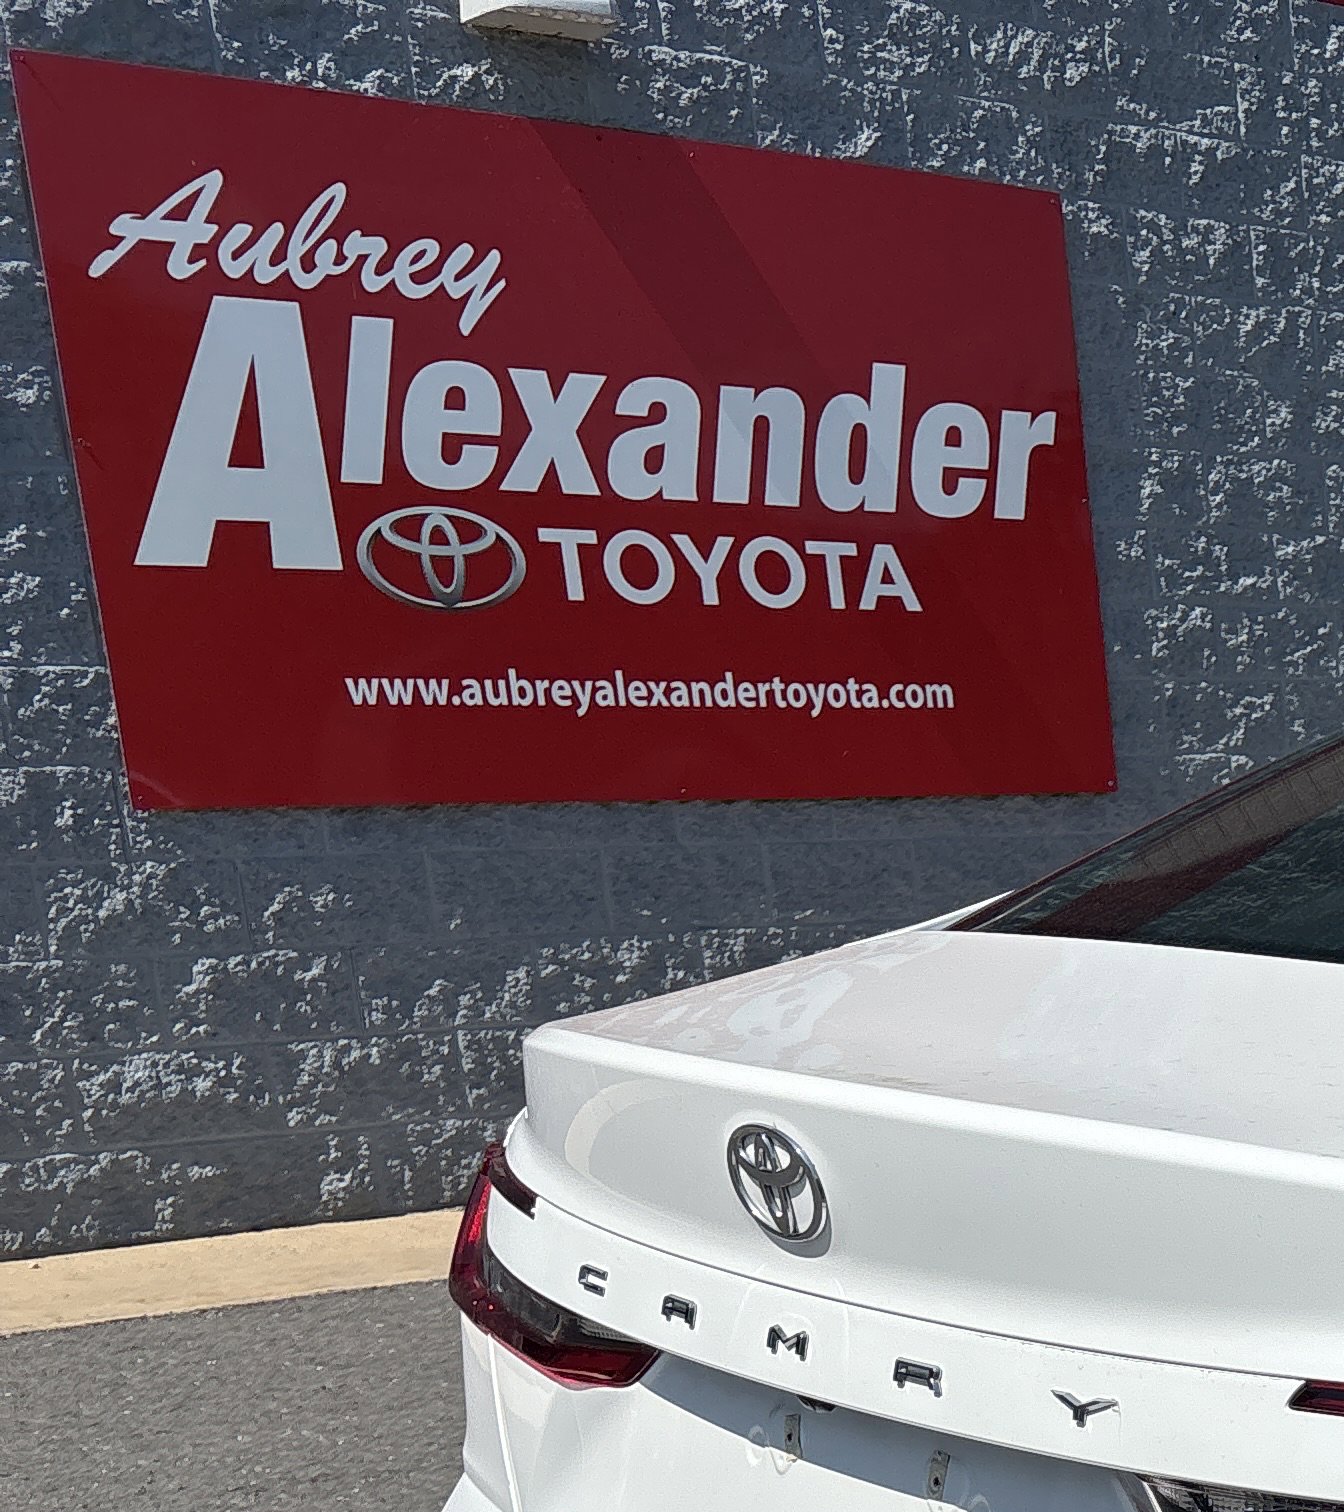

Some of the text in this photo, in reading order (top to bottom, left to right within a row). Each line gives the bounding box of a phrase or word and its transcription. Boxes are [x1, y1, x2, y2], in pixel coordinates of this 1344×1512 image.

[88, 169, 507, 336] Aubrey
[133, 295, 1057, 572] Alexander
[538, 527, 923, 612] TOYOTA
[344, 669, 955, 718] www.aubreyalexandertoyota.com
[578, 1264, 1123, 1428] CAMRY
